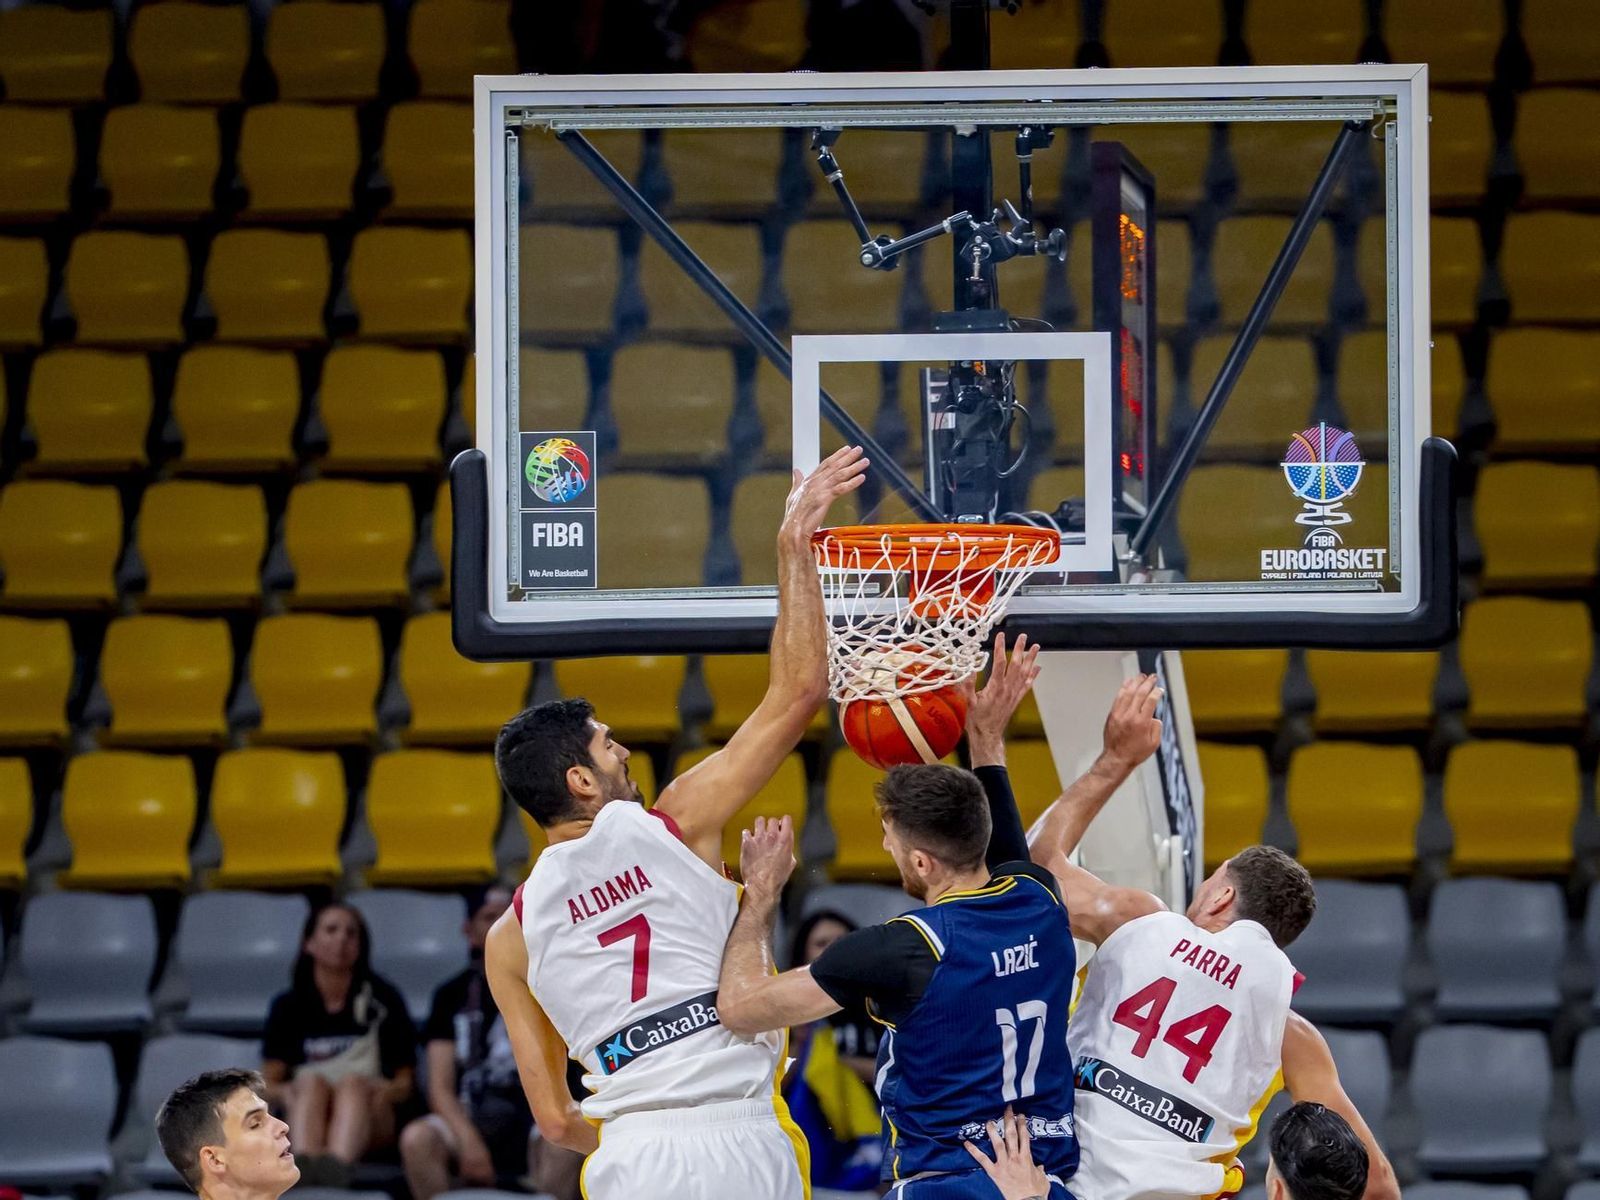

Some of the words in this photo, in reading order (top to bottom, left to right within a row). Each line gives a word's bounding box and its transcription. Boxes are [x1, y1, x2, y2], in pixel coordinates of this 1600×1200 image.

[532, 522, 584, 547] FIBA
[1260, 548, 1387, 571] EUROBASKET
[1312, 535, 1336, 547] FIBA
[528, 569, 541, 578] We
[541, 569, 554, 578] Are
[554, 568, 589, 577] Basketball
[1326, 571, 1353, 579] POLAND
[567, 865, 653, 925] ALDAMA
[597, 913, 651, 1003] 7
[1169, 938, 1243, 990] PARRA
[625, 1003, 720, 1052] CaixaBa
[995, 1000, 1048, 1103] 17
[1112, 976, 1232, 1084] 44
[1094, 1068, 1204, 1142] CaixaBank
